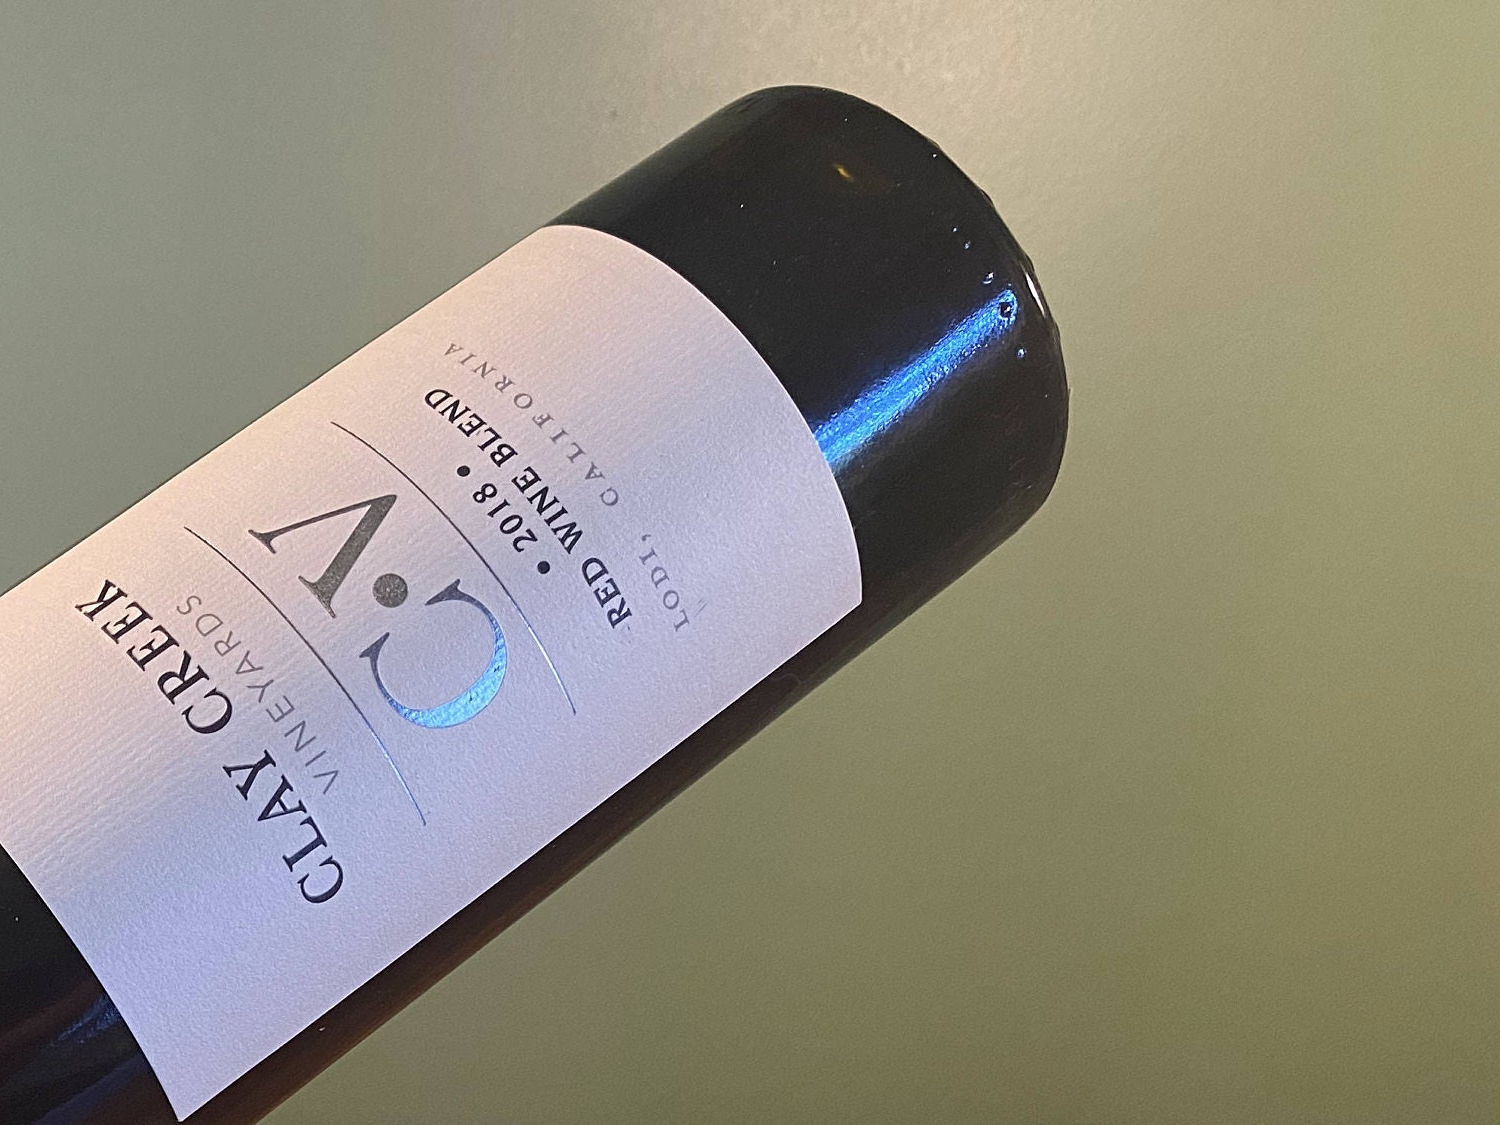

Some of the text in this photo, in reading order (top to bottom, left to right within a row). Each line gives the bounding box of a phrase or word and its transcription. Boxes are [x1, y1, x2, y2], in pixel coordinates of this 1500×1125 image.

[424, 388, 632, 630] RED WINE BLEND
[444, 342, 690, 632] LODI, CALIFORNIA
[472, 482, 539, 553] 2018
[75, 579, 345, 904] CLAY CREEK
[176, 595, 339, 795] VINEYARDS
